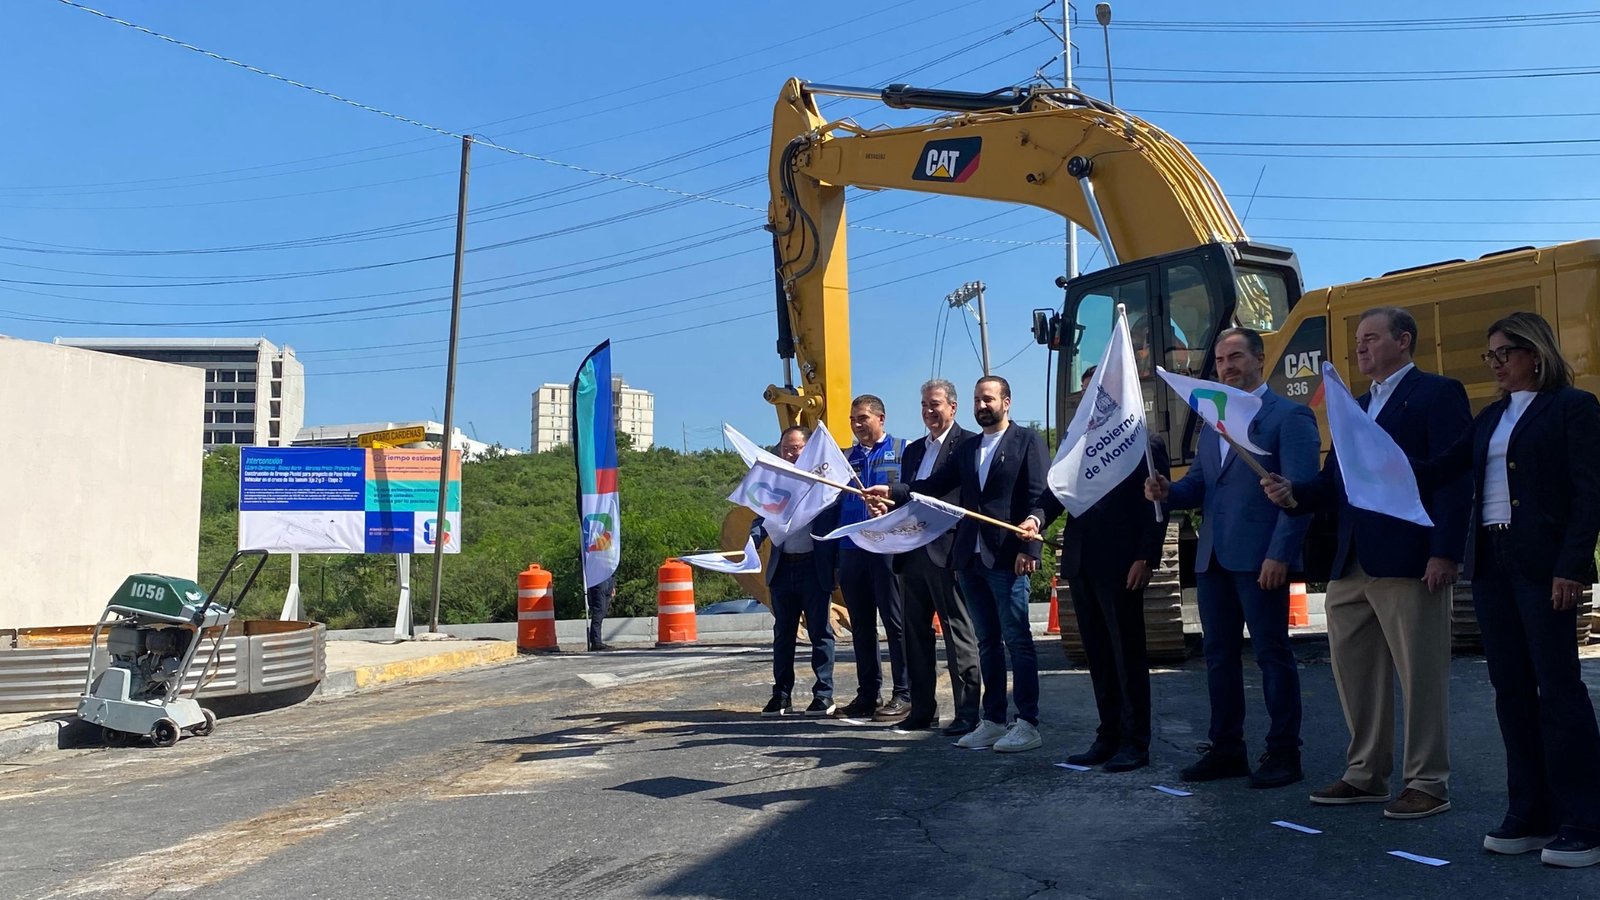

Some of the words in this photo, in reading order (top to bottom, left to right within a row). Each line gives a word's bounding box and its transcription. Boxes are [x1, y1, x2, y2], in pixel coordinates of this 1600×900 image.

[925, 149, 960, 178] CAT
[1284, 350, 1321, 379] CAT
[1286, 381, 1309, 397] 336
[1144, 400, 1154, 411] AT
[391, 428, 422, 440] CARDENAS
[1085, 413, 1135, 458] Gobierno
[384, 454, 410, 462] Tiempo
[1084, 465, 1101, 480] de
[130, 582, 165, 601] 1058
